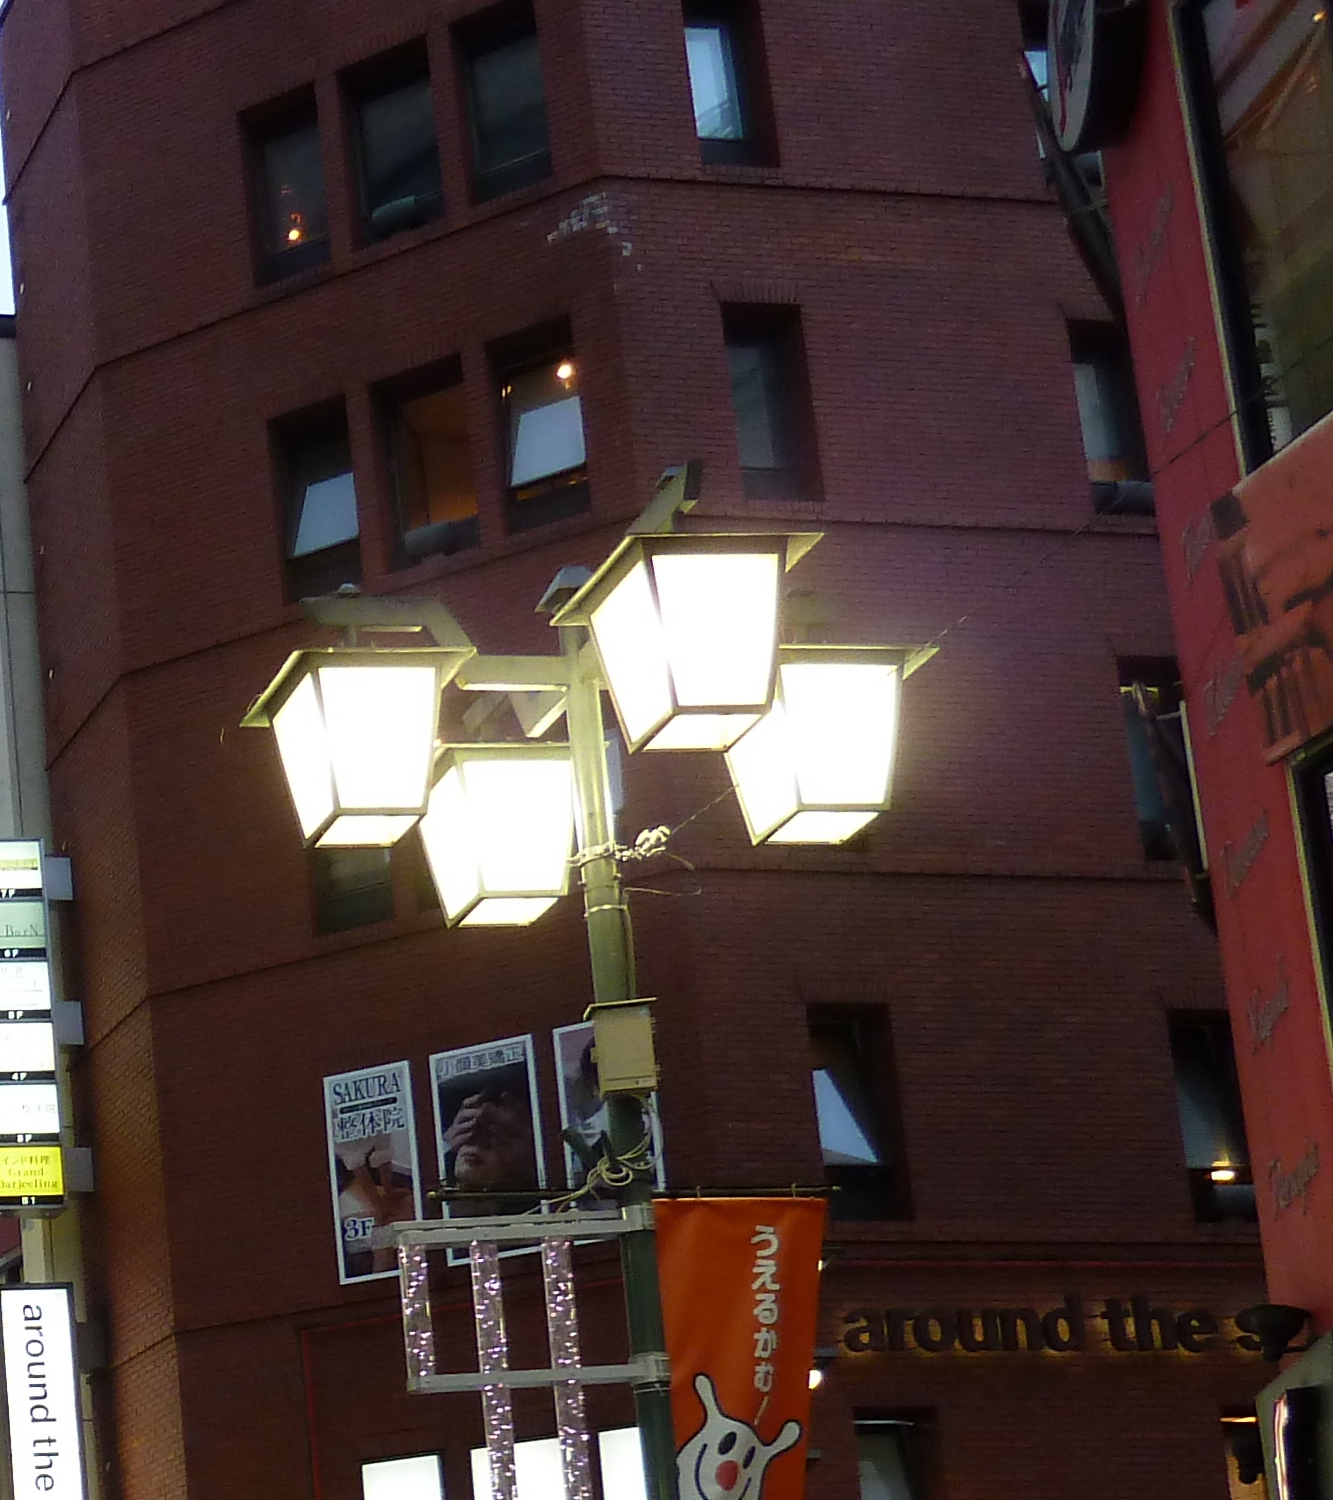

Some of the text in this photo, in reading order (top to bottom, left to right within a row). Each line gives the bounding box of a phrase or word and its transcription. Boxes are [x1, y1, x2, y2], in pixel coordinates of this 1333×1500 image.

[332, 1071, 402, 1106] SAKURA
[335, 1106, 405, 1141] 整体院
[344, 1217, 375, 1240] 3F
[842, 1294, 1086, 1353] around
[1100, 1294, 1220, 1353] the
[22, 1304, 57, 1424] around
[32, 1436, 60, 1492] the
